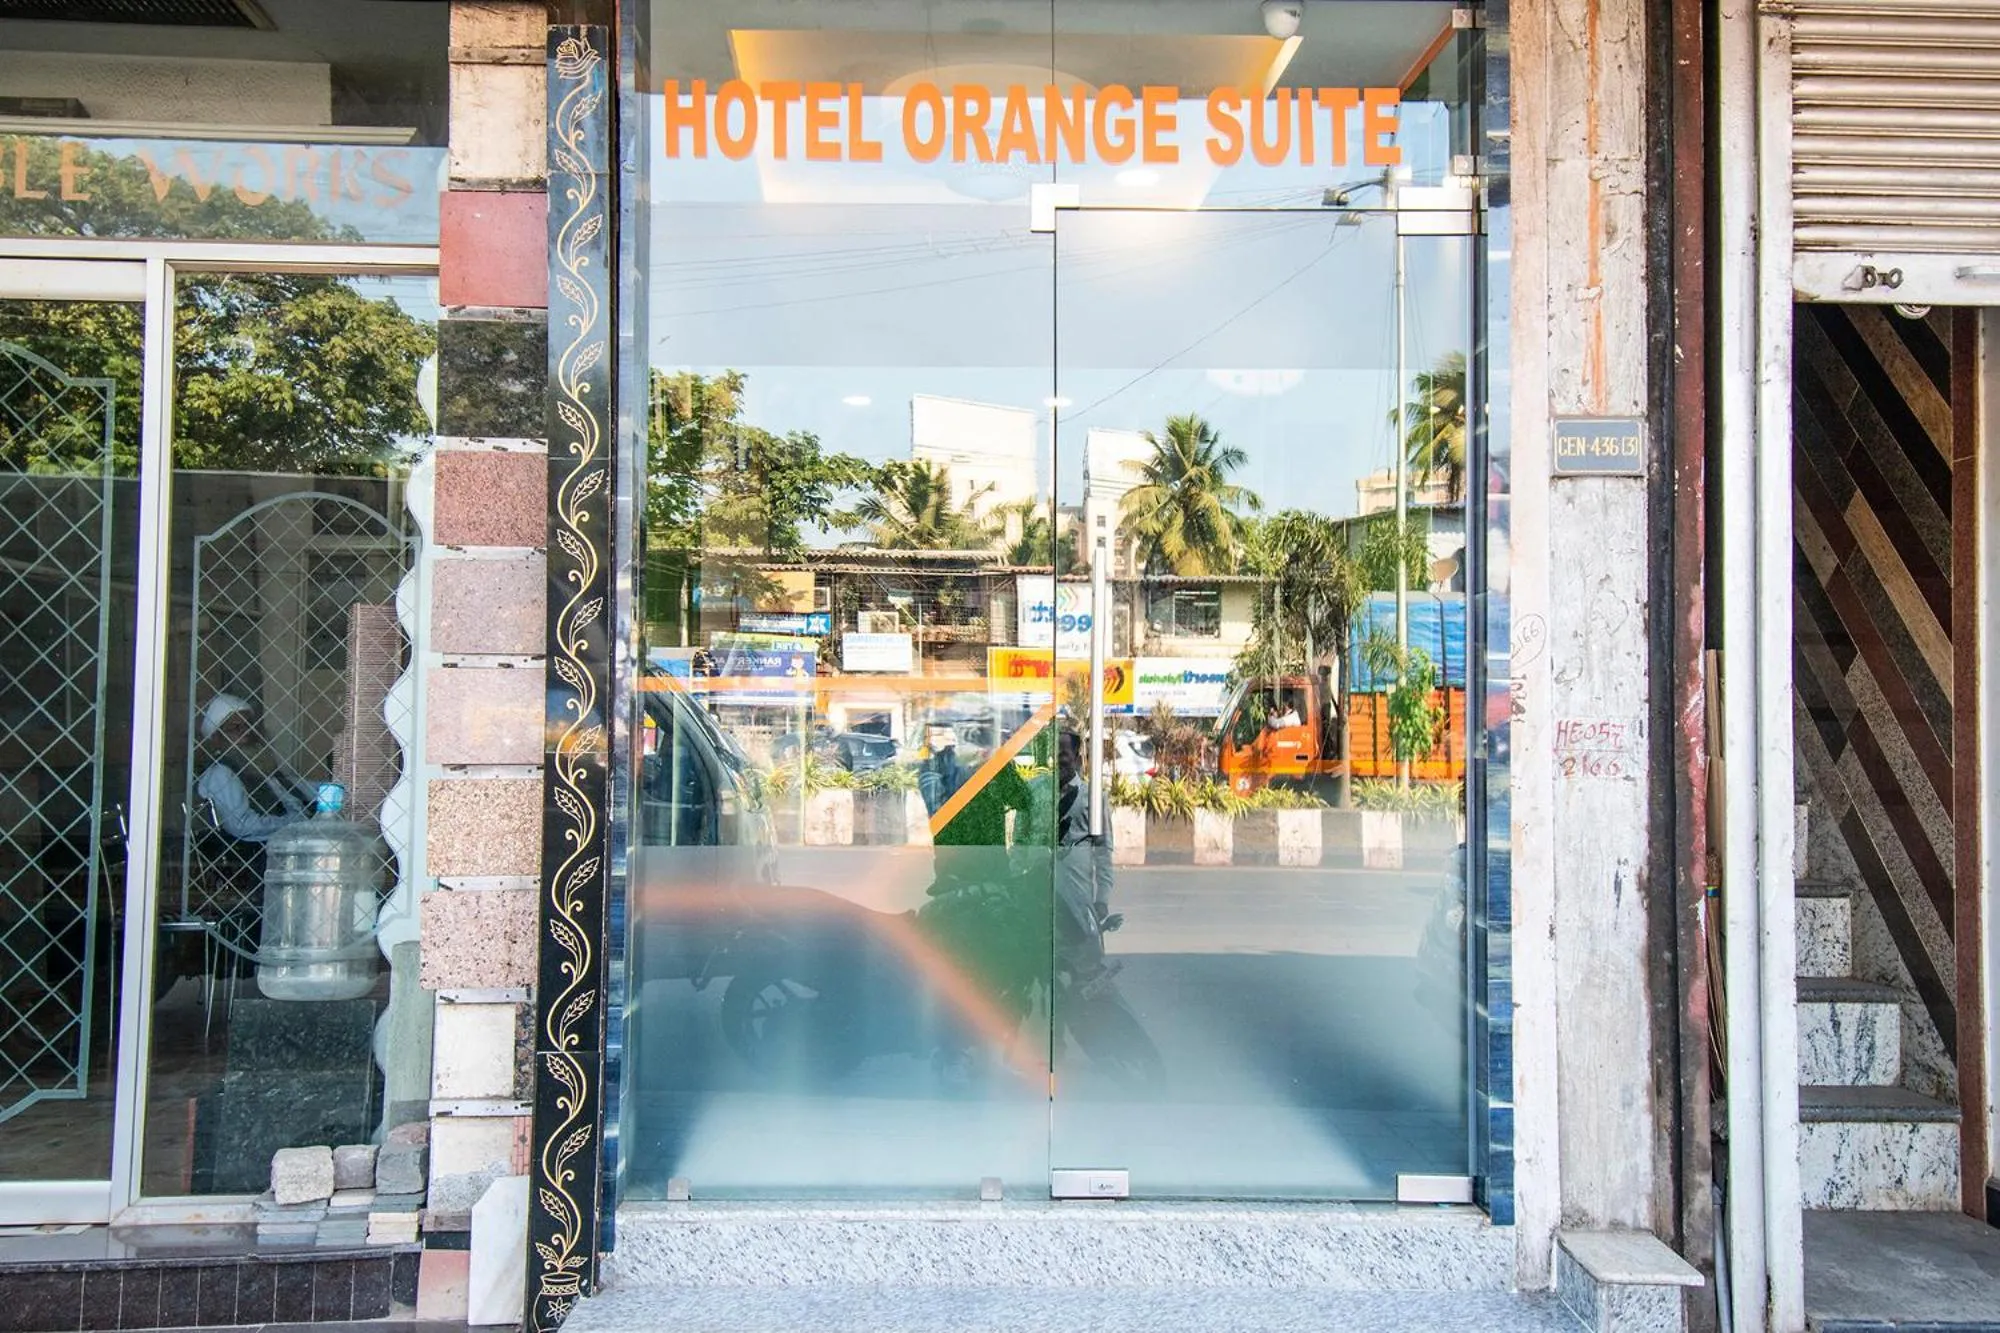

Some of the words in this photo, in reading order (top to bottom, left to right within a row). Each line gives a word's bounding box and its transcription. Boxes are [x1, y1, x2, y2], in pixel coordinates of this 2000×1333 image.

[664, 79, 883, 162] HOTEL
[901, 83, 1179, 165] ORANGE
[1205, 86, 1401, 167] SUITE
[0, 139, 91, 201] LE
[136, 144, 414, 208] WORKS
